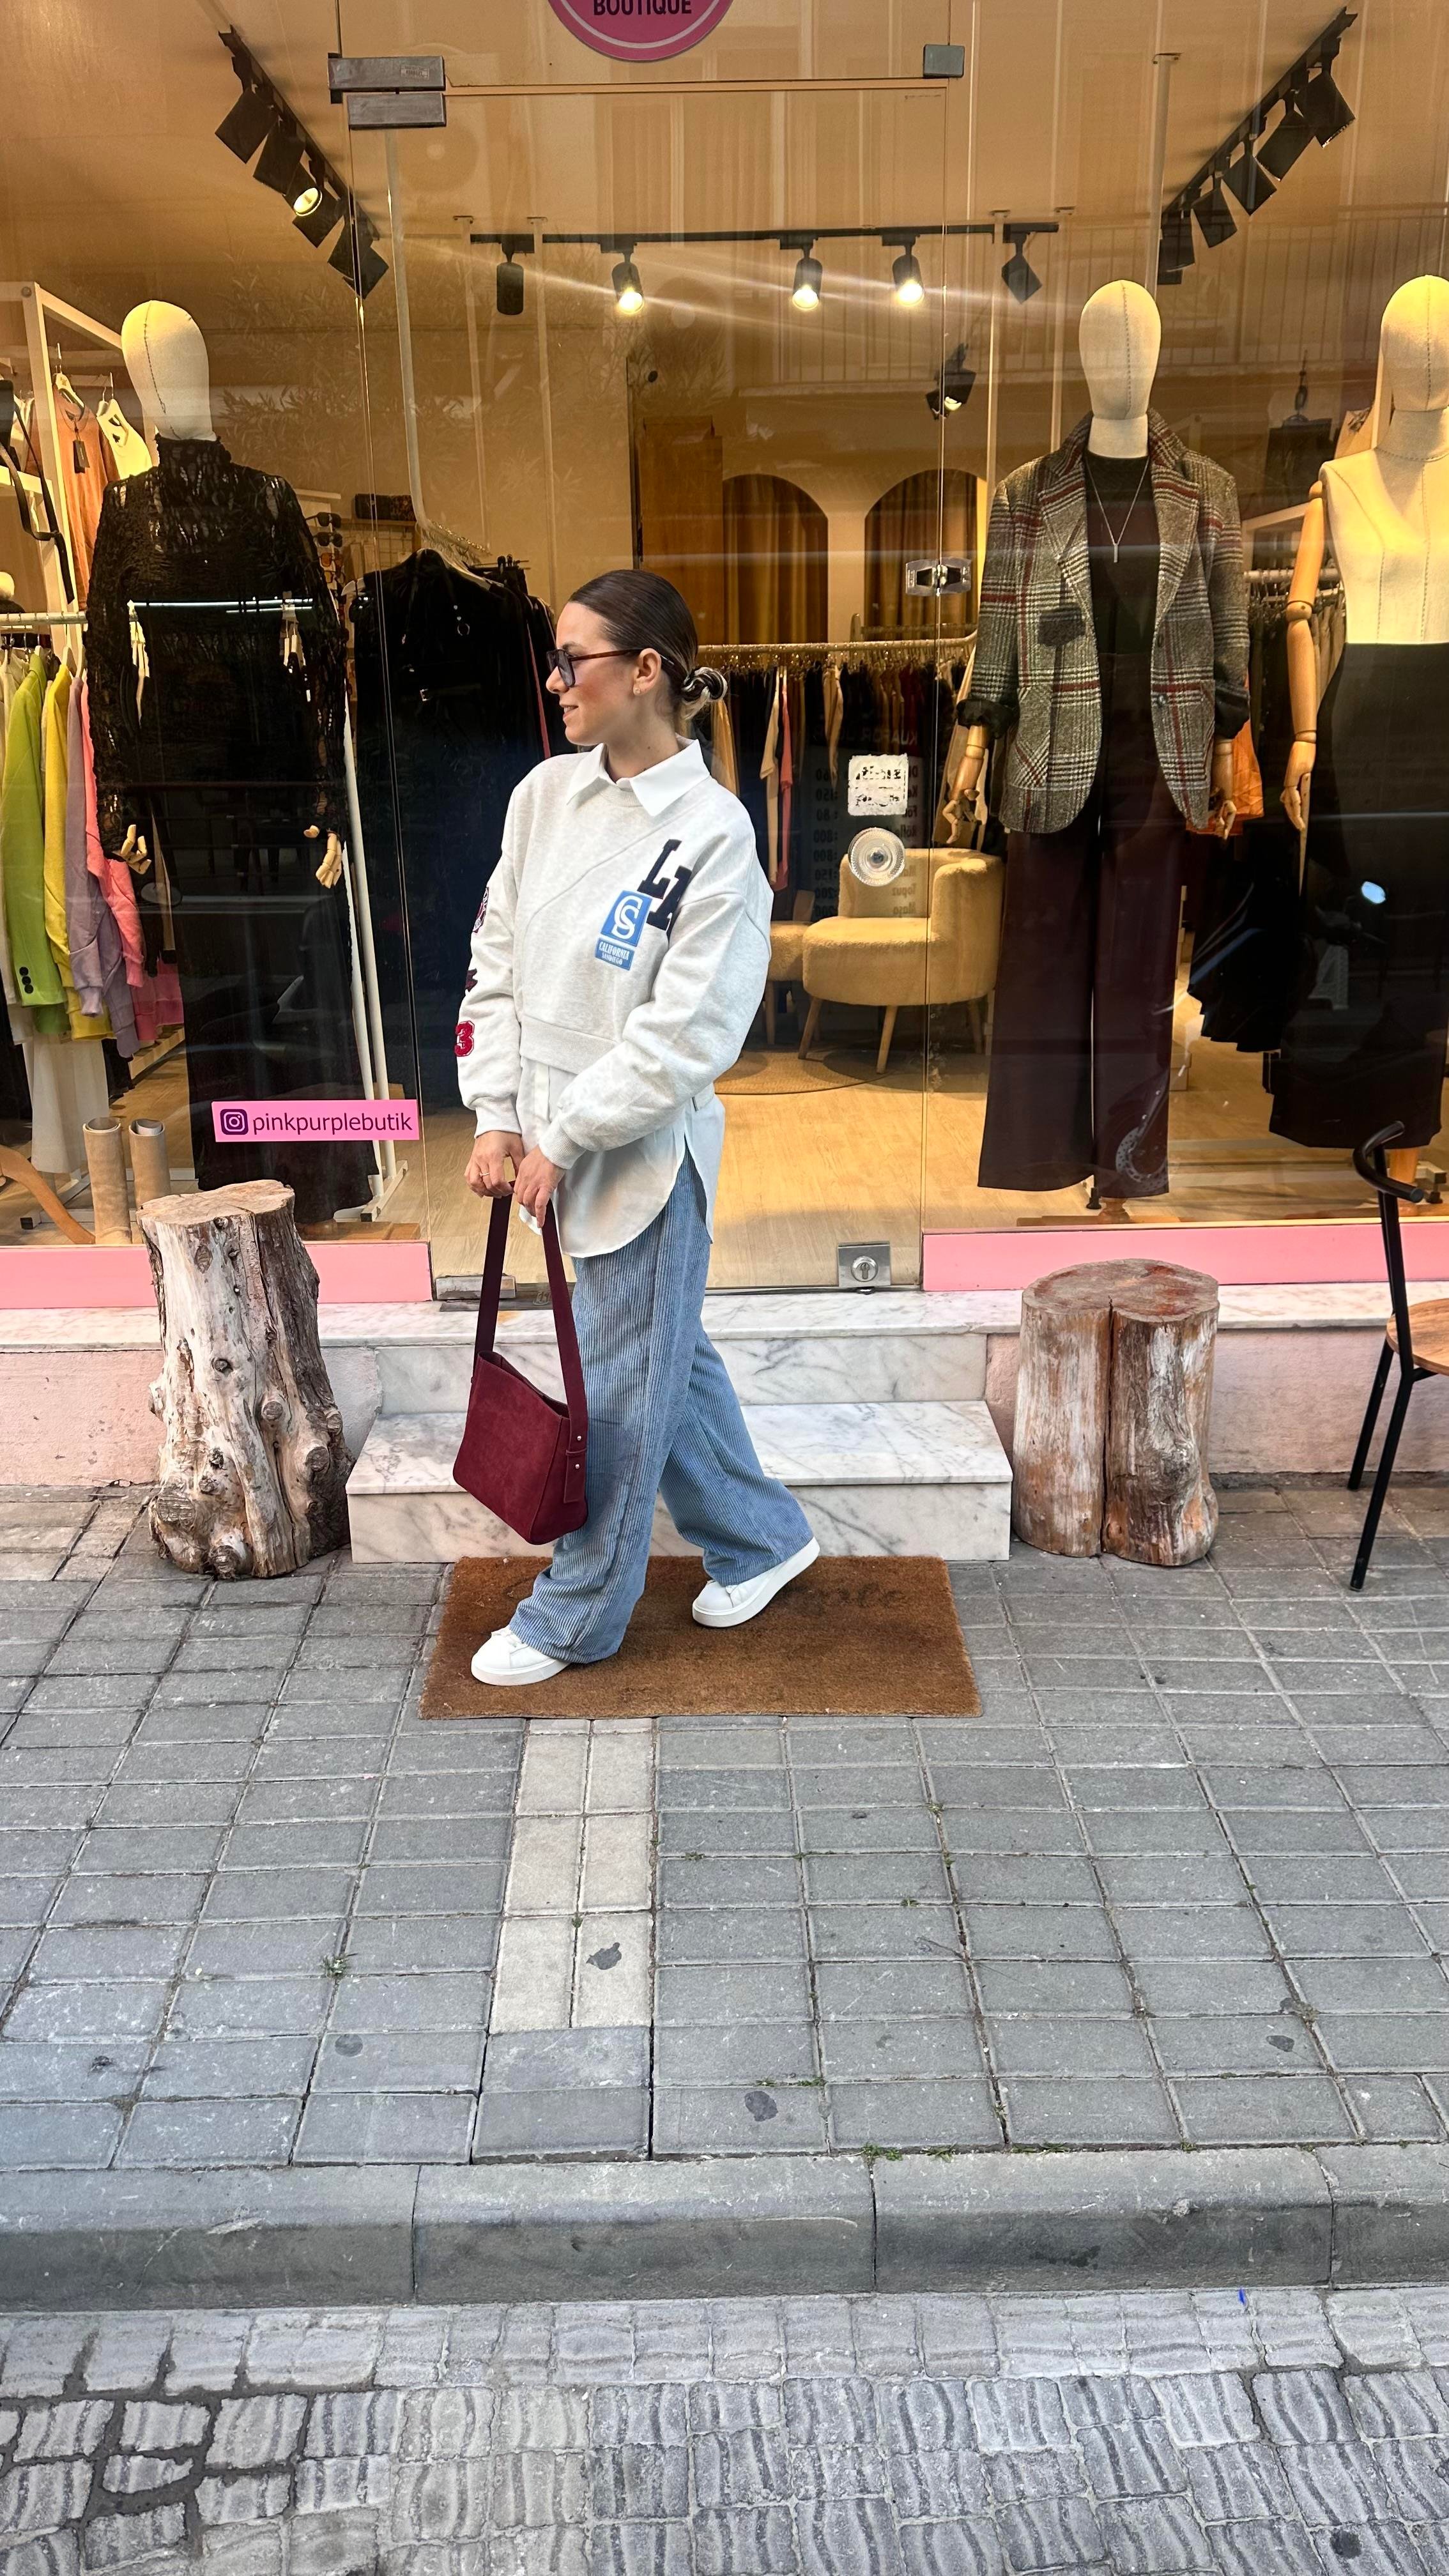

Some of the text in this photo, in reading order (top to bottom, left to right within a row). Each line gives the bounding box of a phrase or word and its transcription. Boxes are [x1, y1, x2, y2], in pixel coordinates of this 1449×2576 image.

[594, 0, 692, 16] BOUTIQUE
[611, 895, 643, 940] S
[454, 1020, 475, 1057] 3
[253, 1113, 413, 1135] pinkpurplebutik
